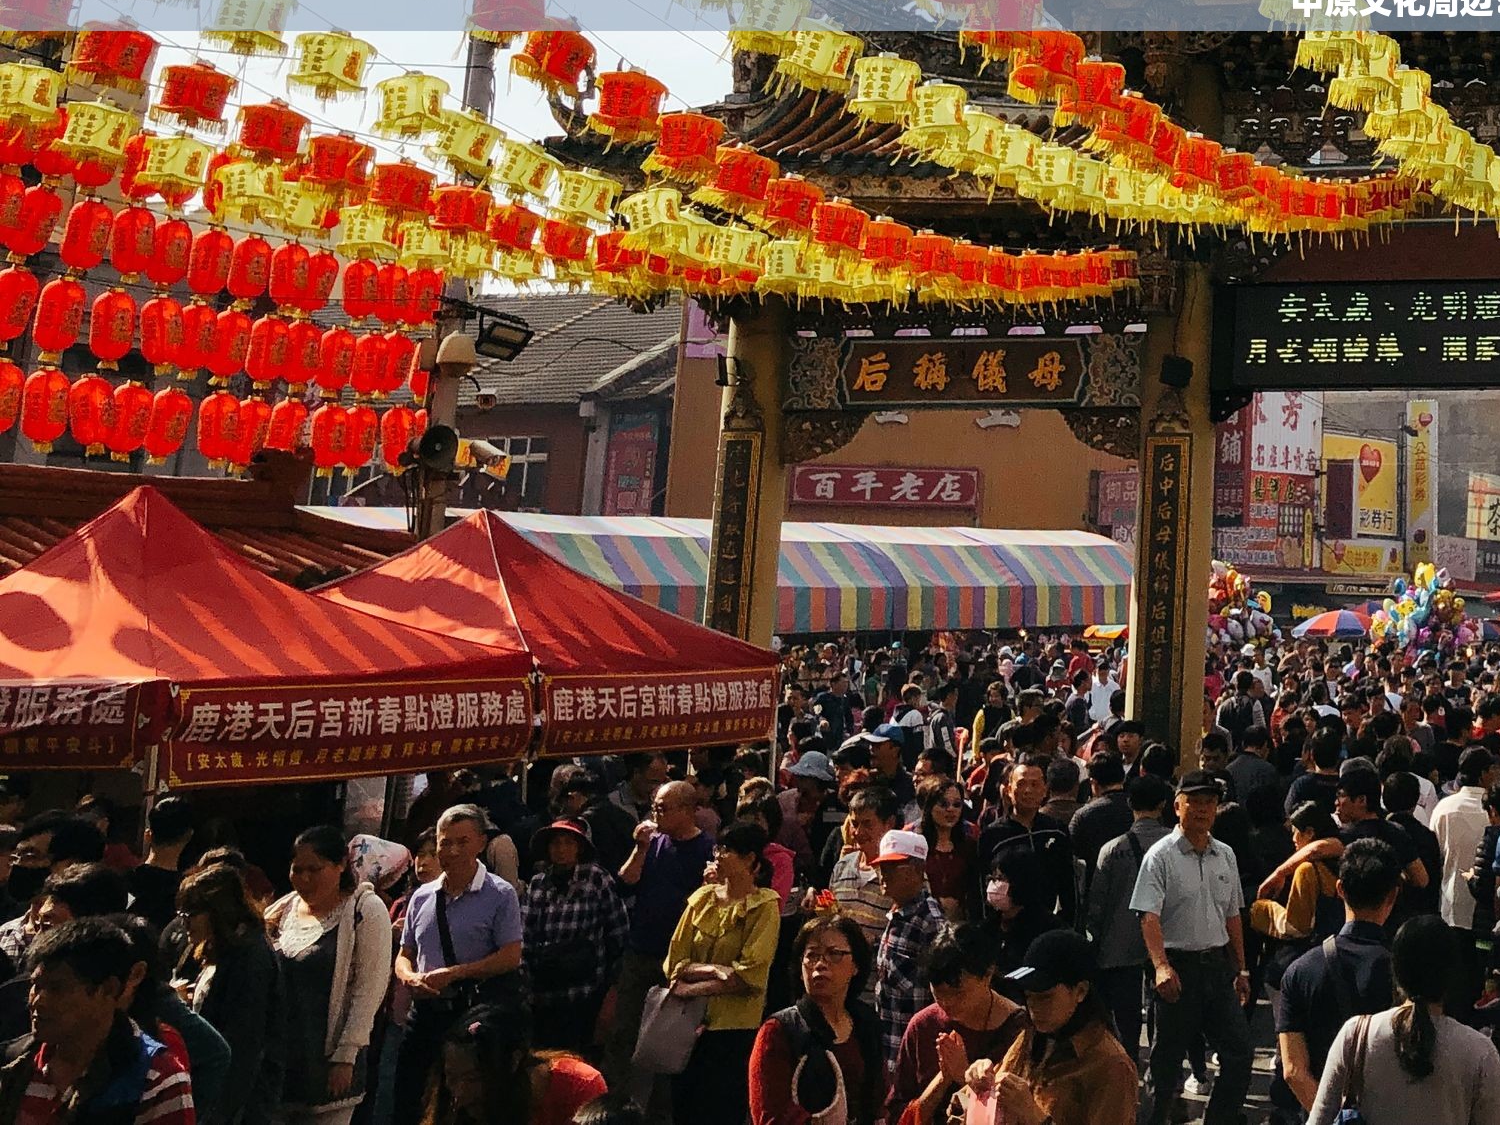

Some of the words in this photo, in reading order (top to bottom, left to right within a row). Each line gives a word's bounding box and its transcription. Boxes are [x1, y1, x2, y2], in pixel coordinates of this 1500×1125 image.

[808, 472, 962, 502] 百年老店
[1359, 508, 1394, 531] 彩券行
[179, 689, 527, 743] 鹿港天后宮新春點燈服務處
[553, 678, 773, 721] 鹿港天后宮新春點燈服務處
